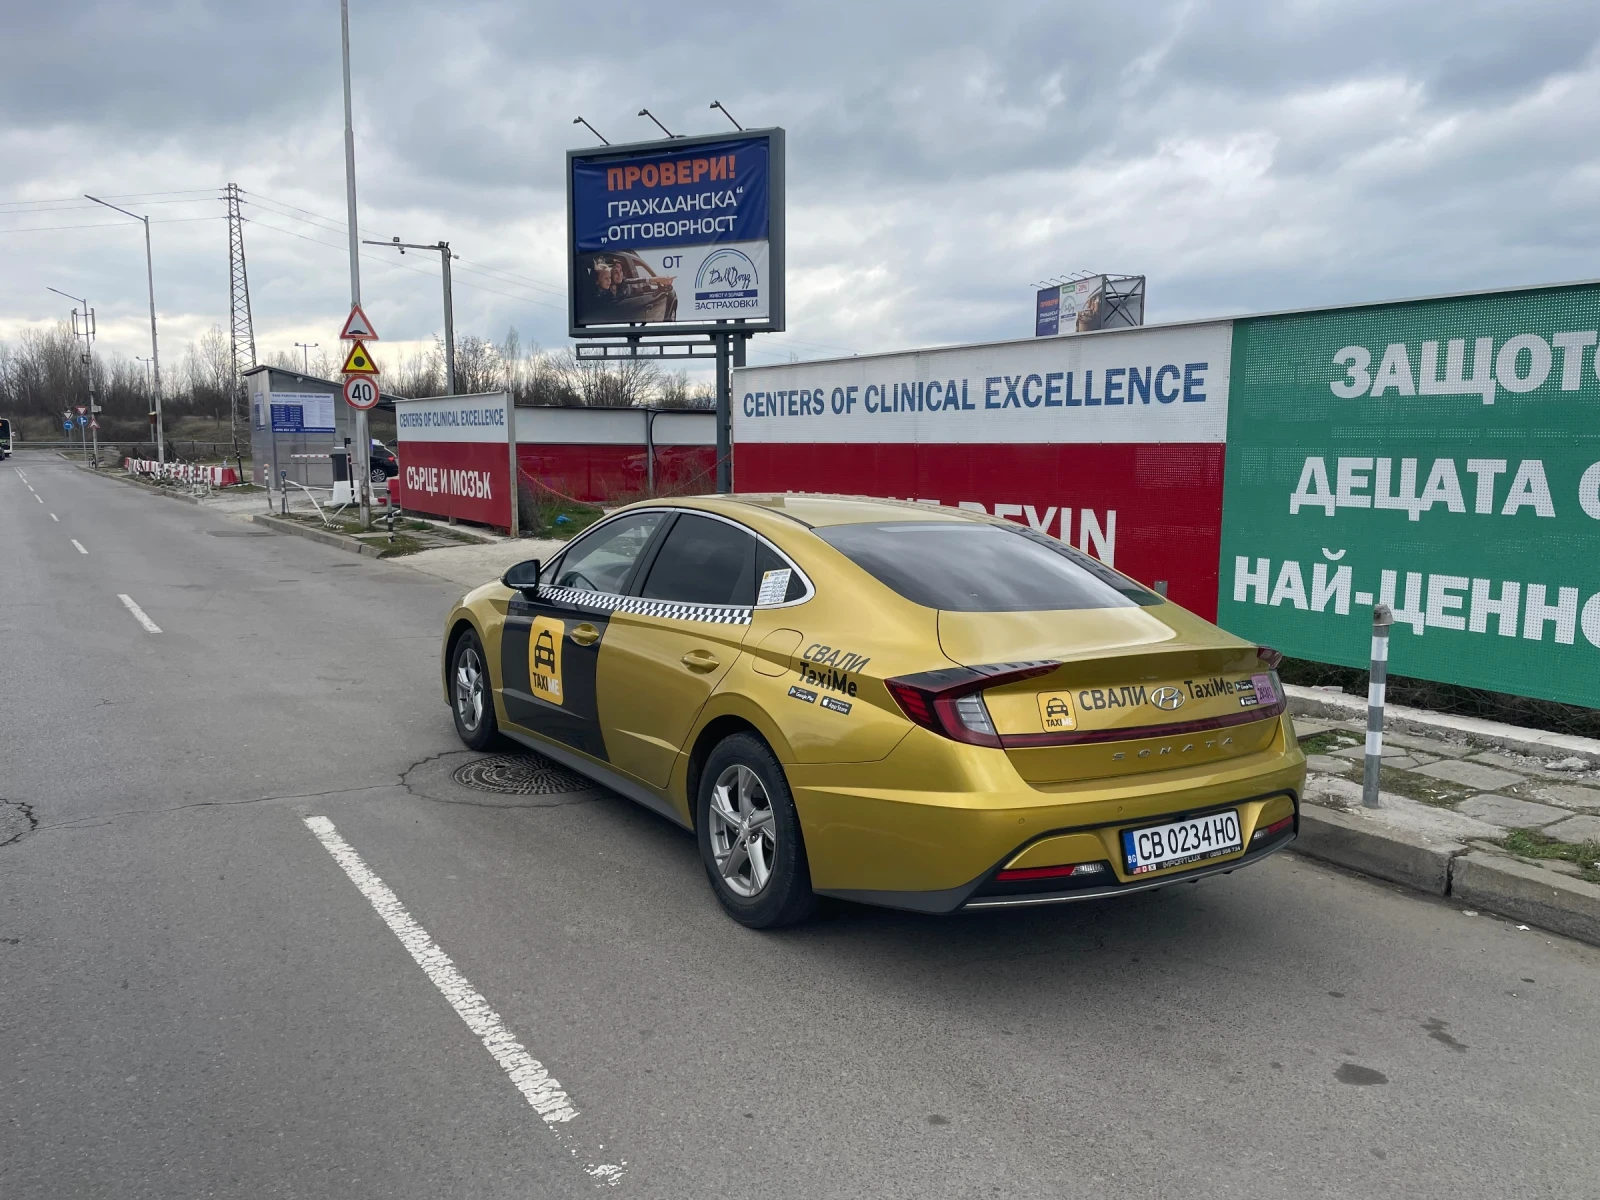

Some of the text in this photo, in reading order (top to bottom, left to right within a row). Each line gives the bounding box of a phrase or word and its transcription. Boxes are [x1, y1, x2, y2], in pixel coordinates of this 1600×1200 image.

[607, 155, 736, 191] ПРОВЕРИ!
[662, 255, 683, 269] ОТ
[695, 299, 758, 310] ЗАСТРАХОВКИ
[1329, 330, 1600, 405] ЗАЩОТ
[352, 384, 372, 401] 40
[743, 362, 1209, 418] CENTERS OF CLINICAL EXCELLENCE
[400, 408, 504, 428] CENTERS OF CLINICAL EXCELLENCE
[406, 465, 492, 500] СЪРЦЕ И МОЗЪК
[1289, 456, 1556, 522] ДЕЦАТА
[803, 643, 871, 674] СВАЛИ
[532, 671, 560, 696] TAXIME
[799, 661, 858, 697] TaxiMe
[1183, 677, 1234, 700] TaxiMe
[795, 691, 808, 700] Google
[807, 694, 815, 703] Play
[828, 702, 838, 711] App
[837, 704, 848, 713] Store
[1078, 685, 1148, 711] СВАЛИ
[1046, 717, 1074, 728] TAXIME
[1112, 737, 1233, 761] SONATA
[1138, 831, 1164, 861] CB
[1167, 821, 1212, 855] 0234
[1127, 854, 1137, 864] BG
[1162, 855, 1201, 868] IMPORTLUX
